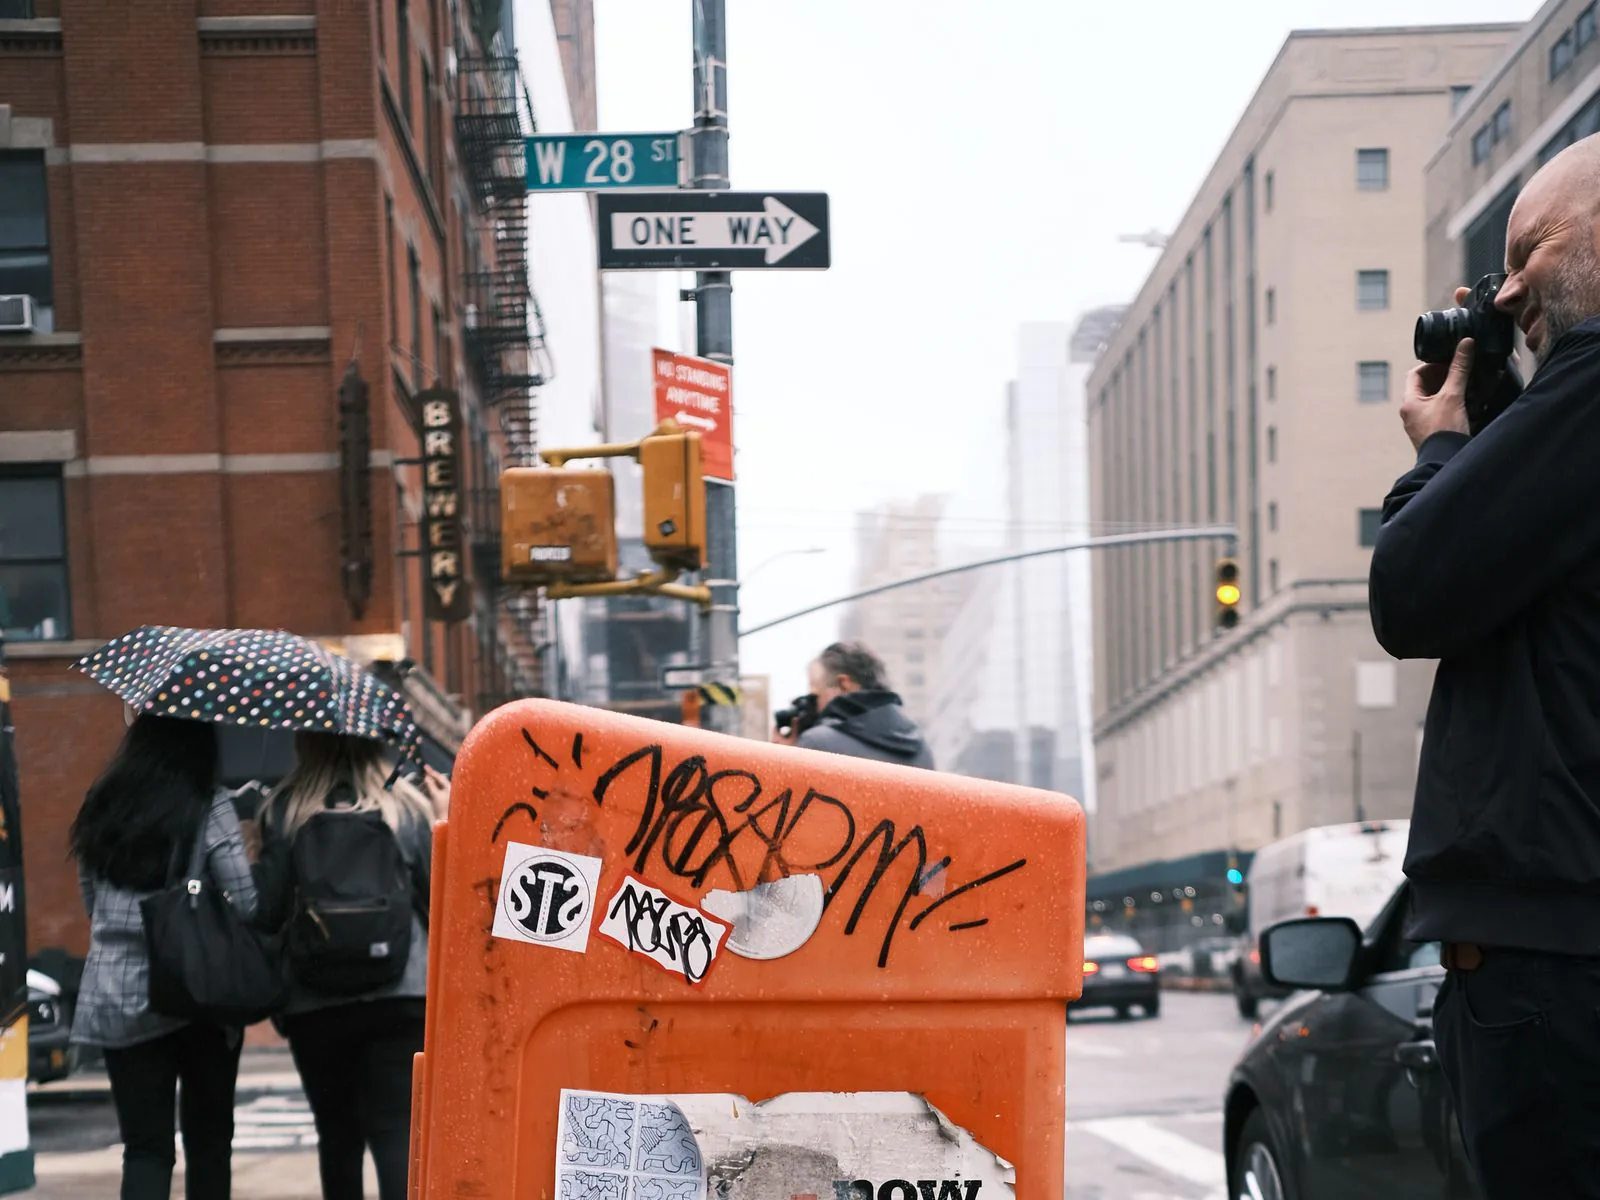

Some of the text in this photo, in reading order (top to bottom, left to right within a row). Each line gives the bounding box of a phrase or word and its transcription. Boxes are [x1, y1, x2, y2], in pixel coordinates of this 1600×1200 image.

[534, 139, 676, 185] W 28 ST
[631, 216, 795, 246] ONE WAY
[656, 359, 728, 392] NO STANDING
[666, 386, 721, 415] ANYTIME
[422, 400, 458, 607] BREWERY
